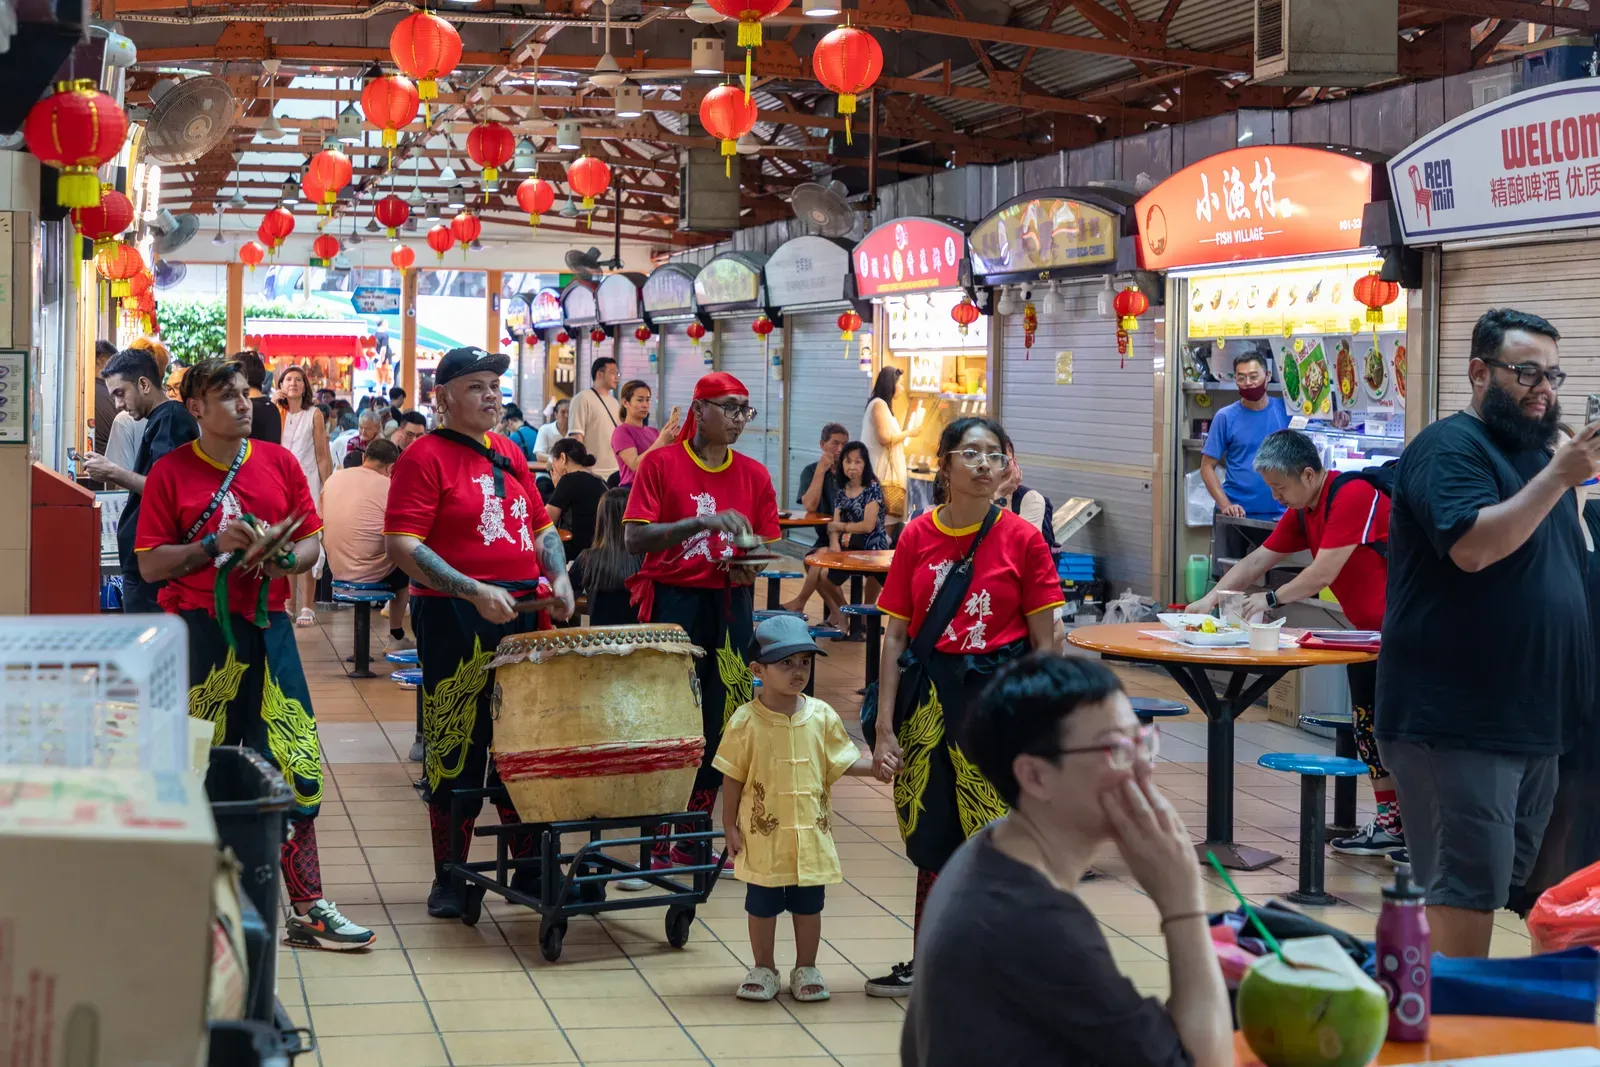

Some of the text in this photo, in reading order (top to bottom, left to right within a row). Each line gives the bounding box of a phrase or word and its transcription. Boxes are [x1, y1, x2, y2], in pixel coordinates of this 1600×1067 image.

[1490, 164, 1600, 208] 精酿啤酒 优质
[1216, 227, 1264, 245] FISH VILLAGE
[220, 470, 236, 491] BATHING
[214, 491, 224, 503] APE
